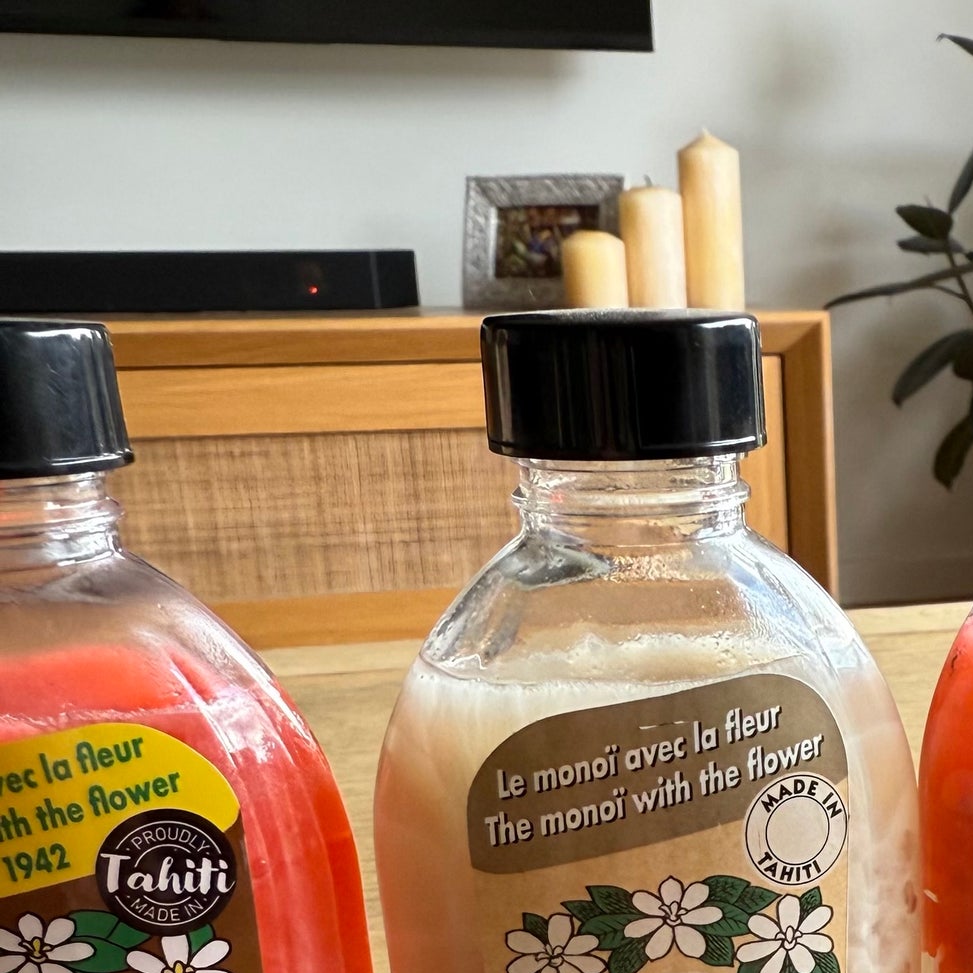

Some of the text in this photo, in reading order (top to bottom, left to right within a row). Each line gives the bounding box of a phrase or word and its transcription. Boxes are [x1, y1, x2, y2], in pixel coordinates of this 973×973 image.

[0, 737, 144, 796] ec la fleur
[496, 704, 782, 800] Le monoï avec la fleur
[0, 772, 181, 843] th the flower
[485, 733, 825, 848] The monoï with the flower
[761, 779, 842, 818] MADE IN
[130, 827, 211, 852] PROUDLY
[2, 843, 71, 882] 1942
[100, 853, 236, 894] Tahiti
[758, 852, 821, 881] TAHITI
[130, 898, 204, 921] MADE IN
